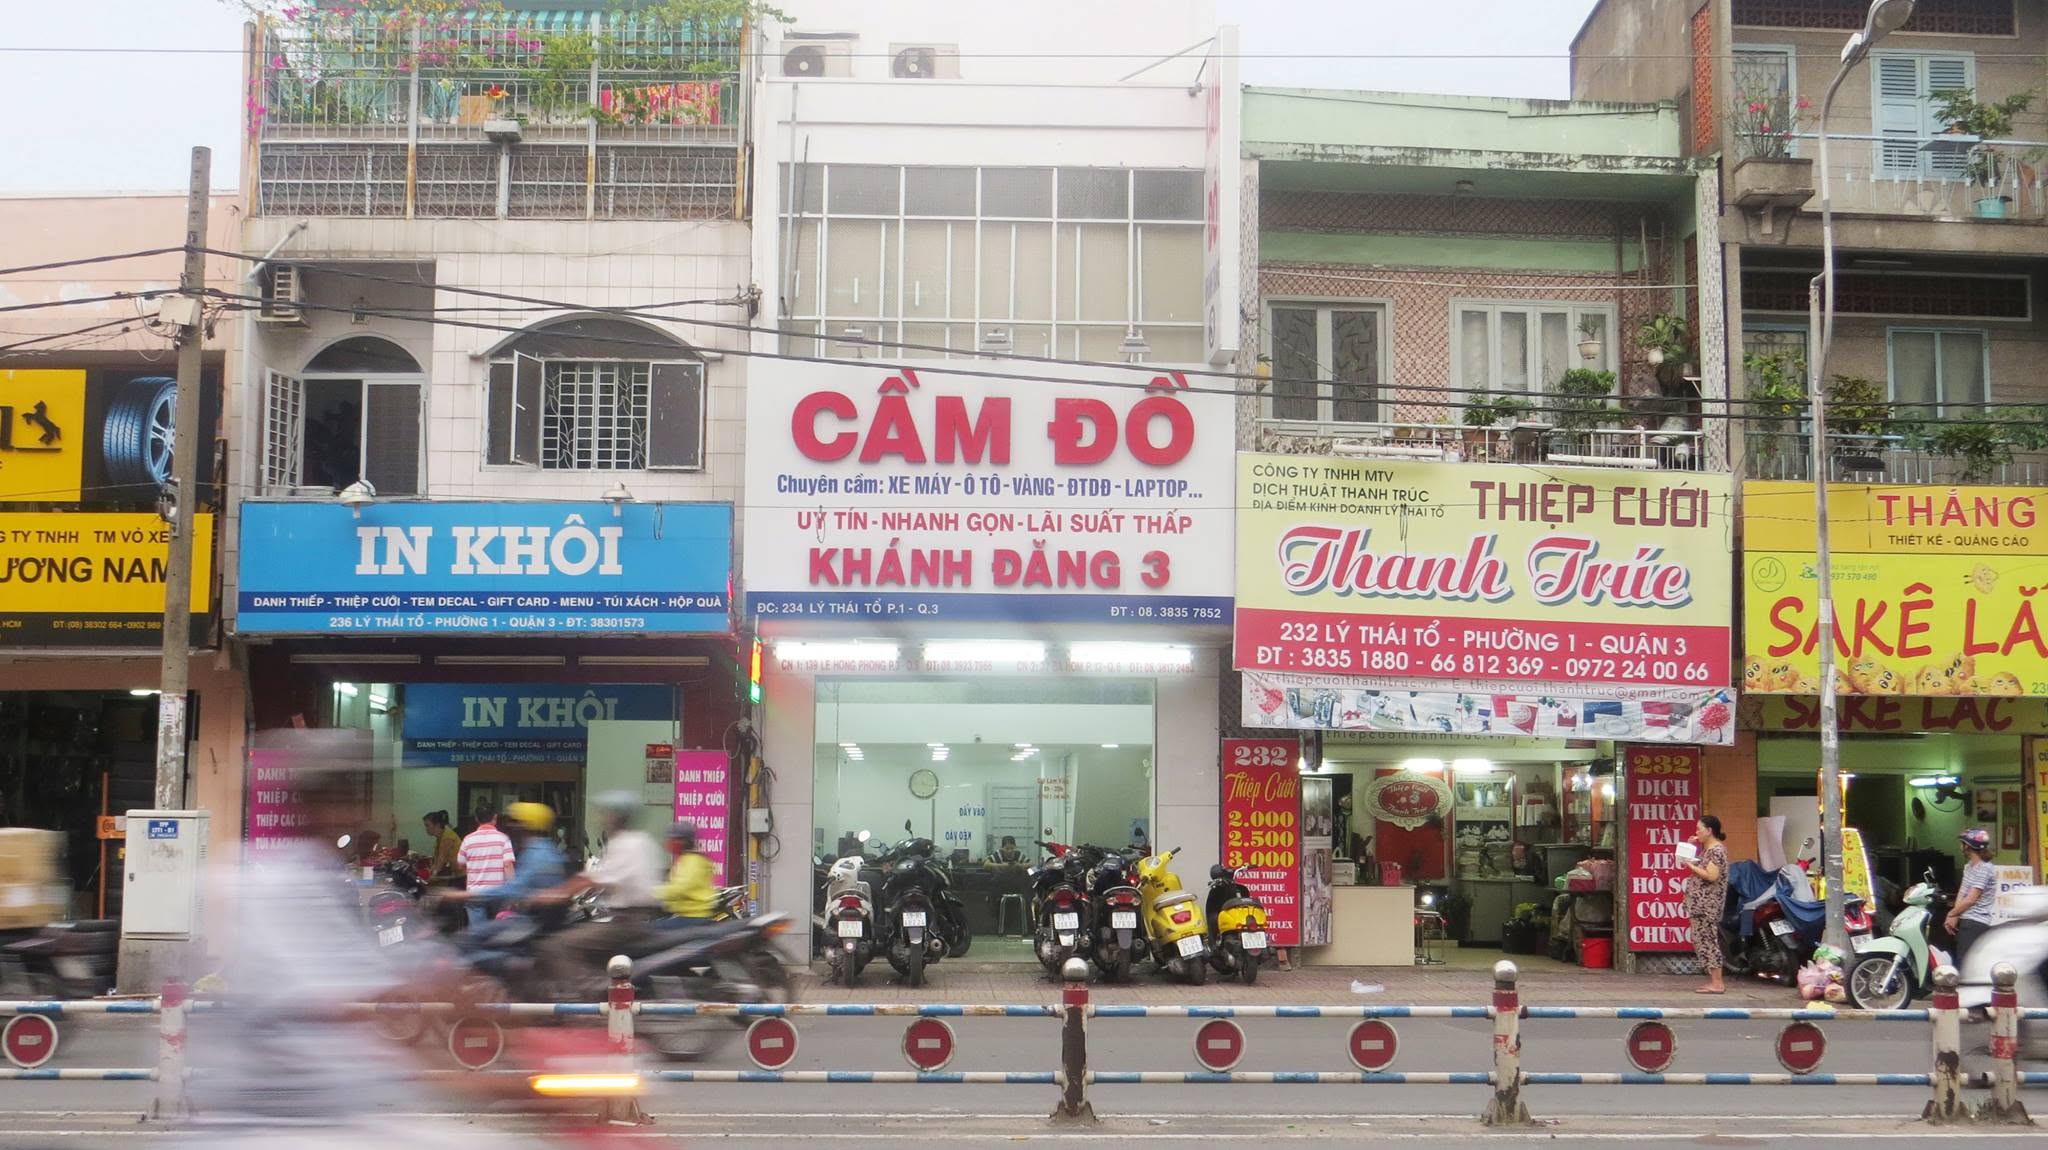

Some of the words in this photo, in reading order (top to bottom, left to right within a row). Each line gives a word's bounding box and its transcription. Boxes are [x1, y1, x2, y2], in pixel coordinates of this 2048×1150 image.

[791, 369, 1012, 465] CẦM
[1047, 372, 1195, 467] ĐỒ
[1253, 462, 1298, 478] CÔNG
[1303, 467, 1319, 478] TY
[1324, 468, 1360, 481] TNHH
[1365, 470, 1394, 482] MTV
[777, 475, 838, 495] Chuyên
[844, 474, 884, 494] cầm:
[888, 475, 910, 494] XE
[914, 474, 952, 494] MÁY
[964, 474, 975, 495] Ô
[979, 475, 1001, 496] TÔ
[1012, 474, 1055, 496] VÀNG
[1067, 478, 1111, 497] ĐTDĐ
[1253, 482, 1288, 496] DỊCH
[1293, 483, 1337, 500] THUẬT
[1342, 487, 1388, 501] THANH
[1393, 486, 1430, 503] TRÚC
[1310, 502, 1337, 513] KINH
[1340, 503, 1382, 515] DOANH
[1470, 476, 1595, 530] THIỆP
[1613, 481, 1708, 528] CƯỚI
[1876, 488, 2036, 528] THẮNG
[834, 506, 868, 530] TÍN
[881, 512, 959, 532] NHANH
[966, 512, 1014, 538] GỌN
[1028, 509, 1062, 533] LÃI
[1071, 508, 1125, 534] SUẤT
[1133, 509, 1193, 534] THẤP
[11, 530, 33, 543] TY
[36, 530, 79, 543] TNHH
[94, 530, 115, 543] TM
[121, 527, 144, 543] VỎ
[148, 530, 170, 543] XE
[355, 526, 432, 575] IN
[451, 514, 622, 576] KHÔI
[2002, 535, 2029, 547] CÁO
[809, 537, 972, 587] KHÁNH
[992, 538, 1121, 588] ĐĂNG
[1141, 550, 1171, 588] 3
[1279, 525, 1513, 602] Thanh
[1527, 535, 1694, 609] Trúc
[253, 597, 287, 608] DANH
[290, 594, 325, 608] THIẾP
[335, 595, 369, 610] THIỆP
[372, 594, 401, 608] CƯỚI
[411, 597, 435, 608] TEM
[438, 597, 478, 608] DECAL
[487, 597, 515, 608] GIFT
[517, 597, 550, 608] CARD
[561, 597, 594, 608] MENU
[603, 595, 623, 608] TÚI
[625, 595, 659, 608] XÁCH
[668, 595, 694, 610] HỘP
[696, 595, 722, 609] QUÀ
[757, 603, 779, 614] ĐC:
[782, 603, 803, 614] 234
[809, 601, 825, 614] LÝ
[829, 601, 858, 614] THÁI
[864, 598, 882, 614] TỔ
[887, 603, 904, 614] P.1
[917, 603, 939, 615] Q.3
[329, 617, 352, 628] 236
[355, 614, 371, 628] LÝ
[374, 613, 404, 628] THÁI
[407, 612, 424, 628] TỔ
[435, 614, 488, 629] PHƯỜNG
[492, 617, 498, 627] 1
[509, 614, 545, 630] QUẬN
[547, 617, 556, 628] 3
[566, 617, 587, 628] ĐT:
[590, 617, 645, 629] 38301573
[1159, 607, 1189, 618] 3835
[1192, 607, 1222, 619] 7852
[1767, 582, 1934, 658] SAKÊ
[1280, 622, 1318, 642] 232
[1325, 620, 1350, 643] LÝ
[1359, 621, 1407, 646] THÁI
[1413, 619, 1441, 647] TỔ
[1463, 626, 1559, 653] PHƯỜNG
[1568, 634, 1575, 652] 1
[1600, 632, 1668, 658] QUẬN
[1674, 637, 1687, 656] 3
[1301, 648, 1352, 668] 3835
[1361, 650, 1409, 670] 1880
[1430, 653, 1456, 673] 66
[1462, 655, 1499, 674] 812
[1506, 656, 1544, 676] 369
[1565, 658, 1615, 678] 0972
[1622, 660, 1647, 679] 24
[1653, 661, 1678, 680] 00
[1684, 662, 1709, 681] 66
[462, 697, 507, 728] IN
[517, 689, 619, 728] KHÔI
[1234, 746, 1288, 767] 232
[1633, 755, 1693, 775] 232
[679, 769, 701, 783] DANH
[703, 764, 725, 783] THIẾP
[679, 789, 703, 810] THIỆP
[705, 789, 725, 806] CƯỚI
[1225, 771, 1262, 808] Thiệp
[1637, 779, 1690, 800] DỊCH
[1228, 810, 1295, 828] 2.000
[1629, 799, 1697, 825] THUẬT
[1228, 830, 1295, 848] 2.500
[1646, 824, 1681, 845] TÀI
[1228, 850, 1295, 868] 3.000
